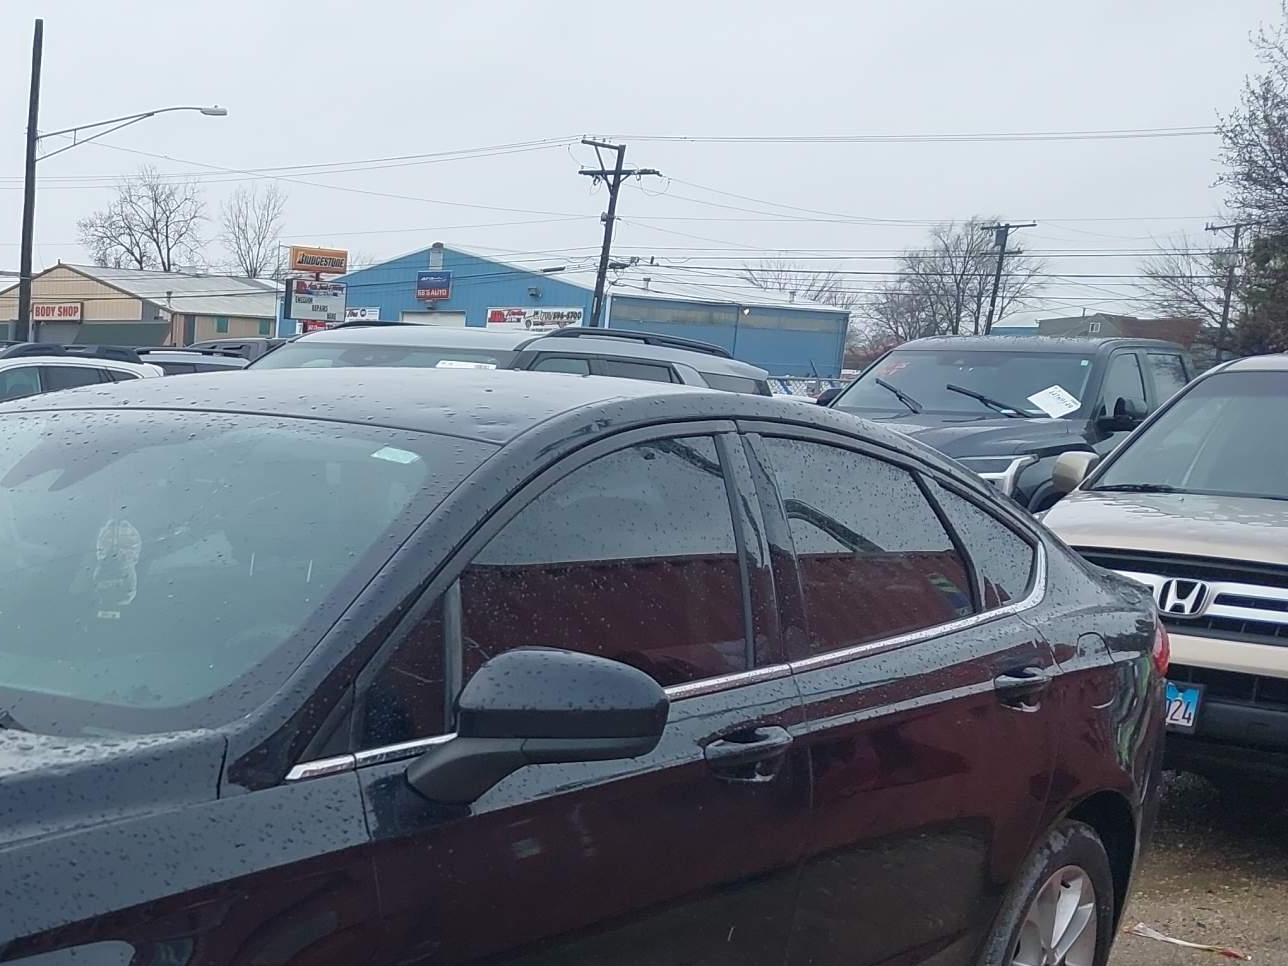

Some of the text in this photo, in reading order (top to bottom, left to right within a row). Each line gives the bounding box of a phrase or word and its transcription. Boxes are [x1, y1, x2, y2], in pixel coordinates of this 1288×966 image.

[297, 252, 344, 268] BRIDGESTONE
[35, 306, 79, 317] BODY SHOP
